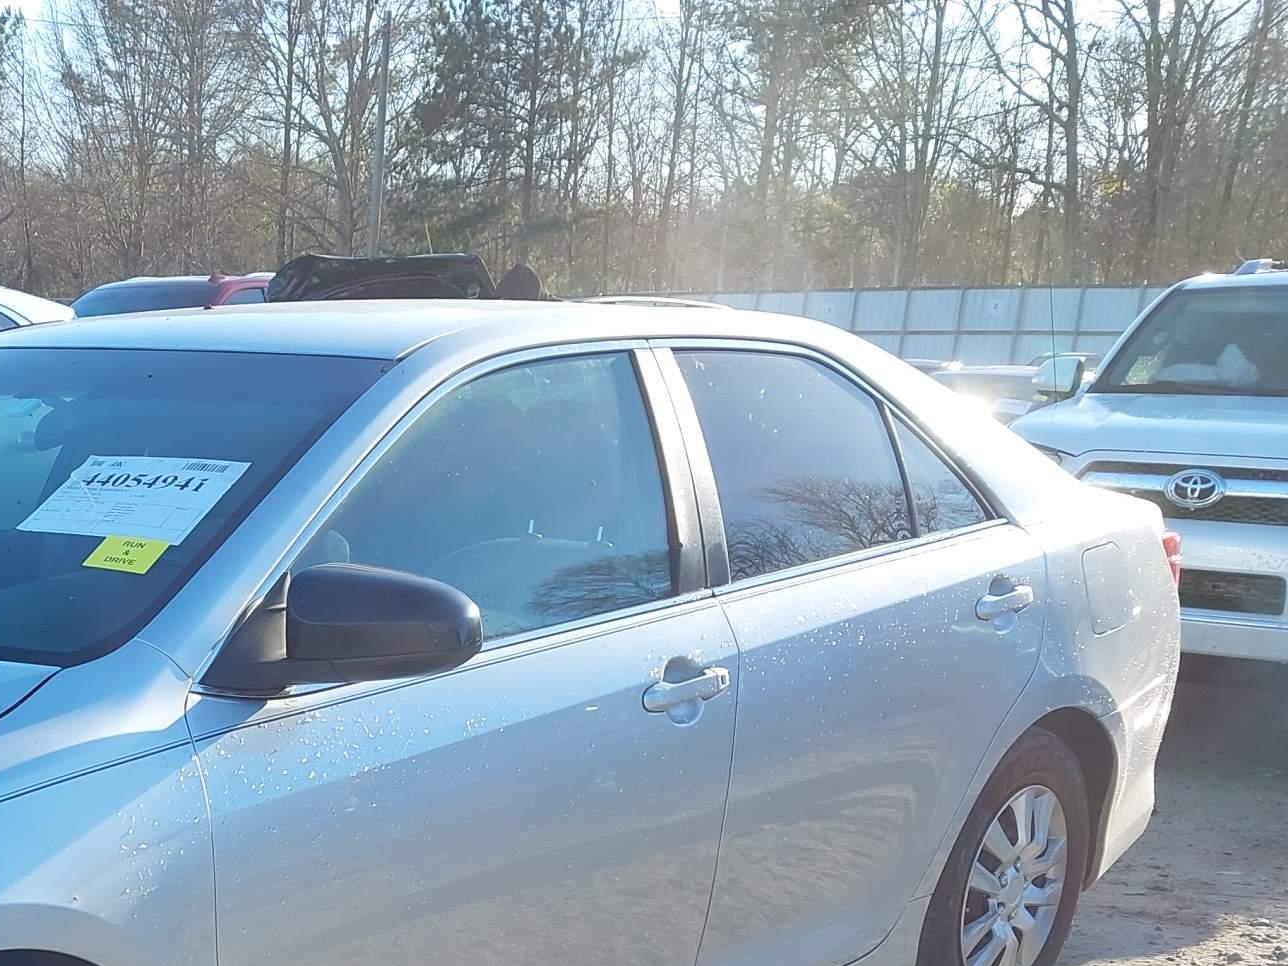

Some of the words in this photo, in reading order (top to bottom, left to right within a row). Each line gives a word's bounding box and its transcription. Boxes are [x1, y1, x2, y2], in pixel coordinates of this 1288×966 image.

[81, 472, 210, 493] 44054941
[122, 540, 146, 549] RUN
[103, 555, 137, 566] DRIVE
